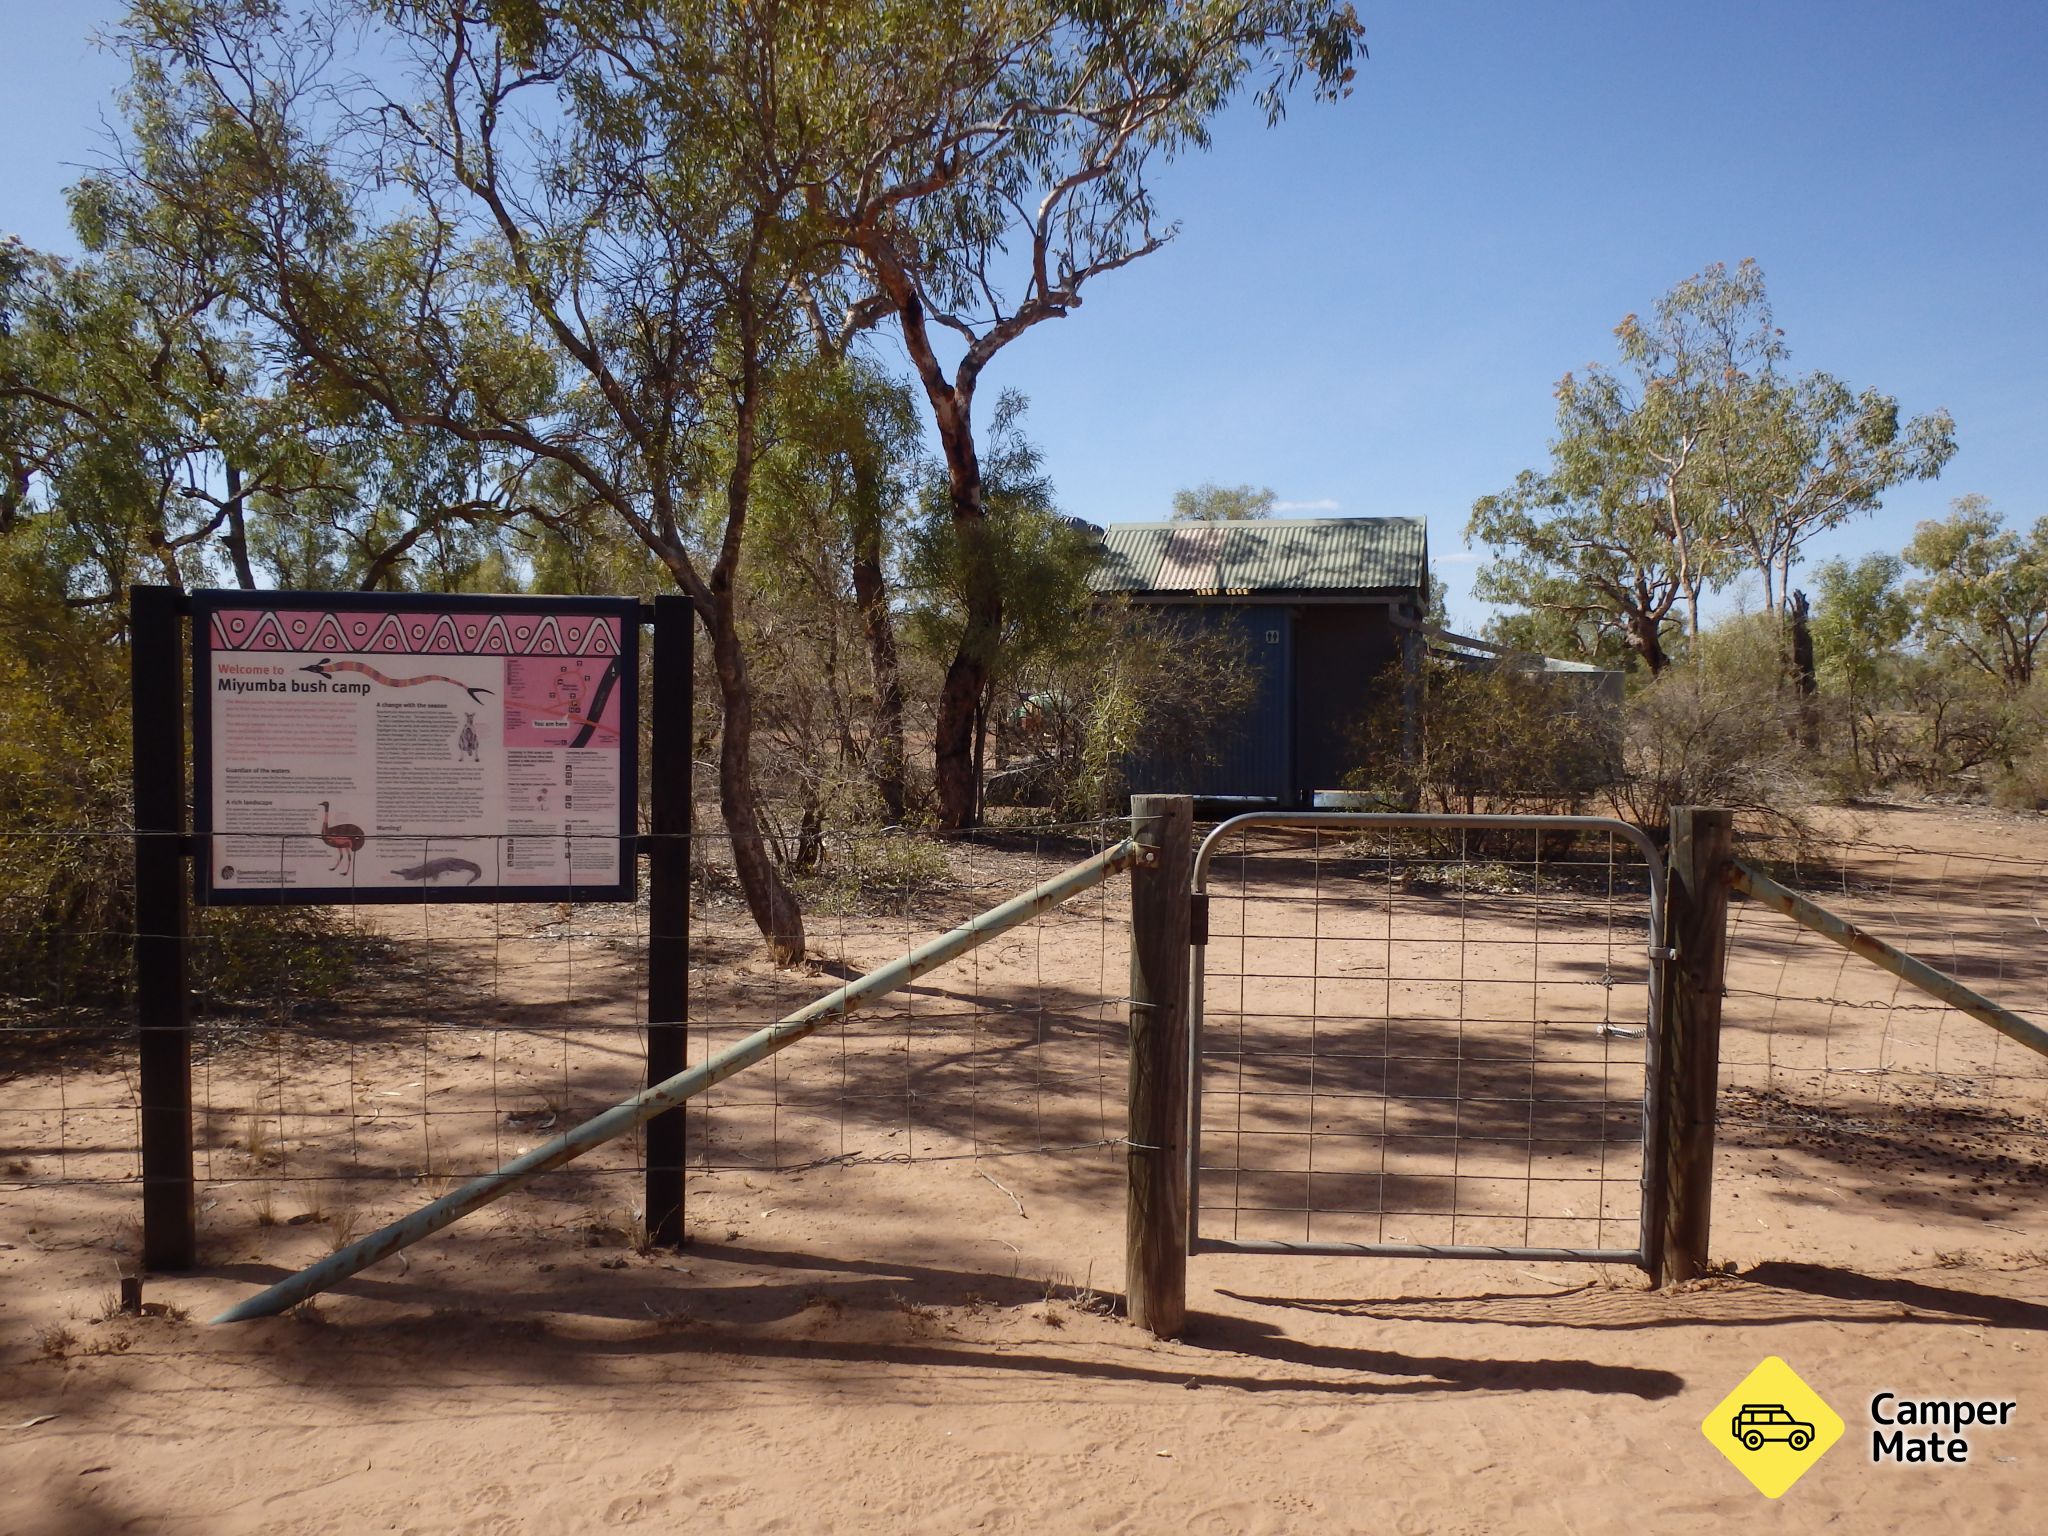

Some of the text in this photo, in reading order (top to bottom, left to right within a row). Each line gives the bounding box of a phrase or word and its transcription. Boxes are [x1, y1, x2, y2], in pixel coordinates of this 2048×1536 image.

[218, 664, 285, 675] Welcome to
[218, 679, 371, 696] Miyumba bush camp
